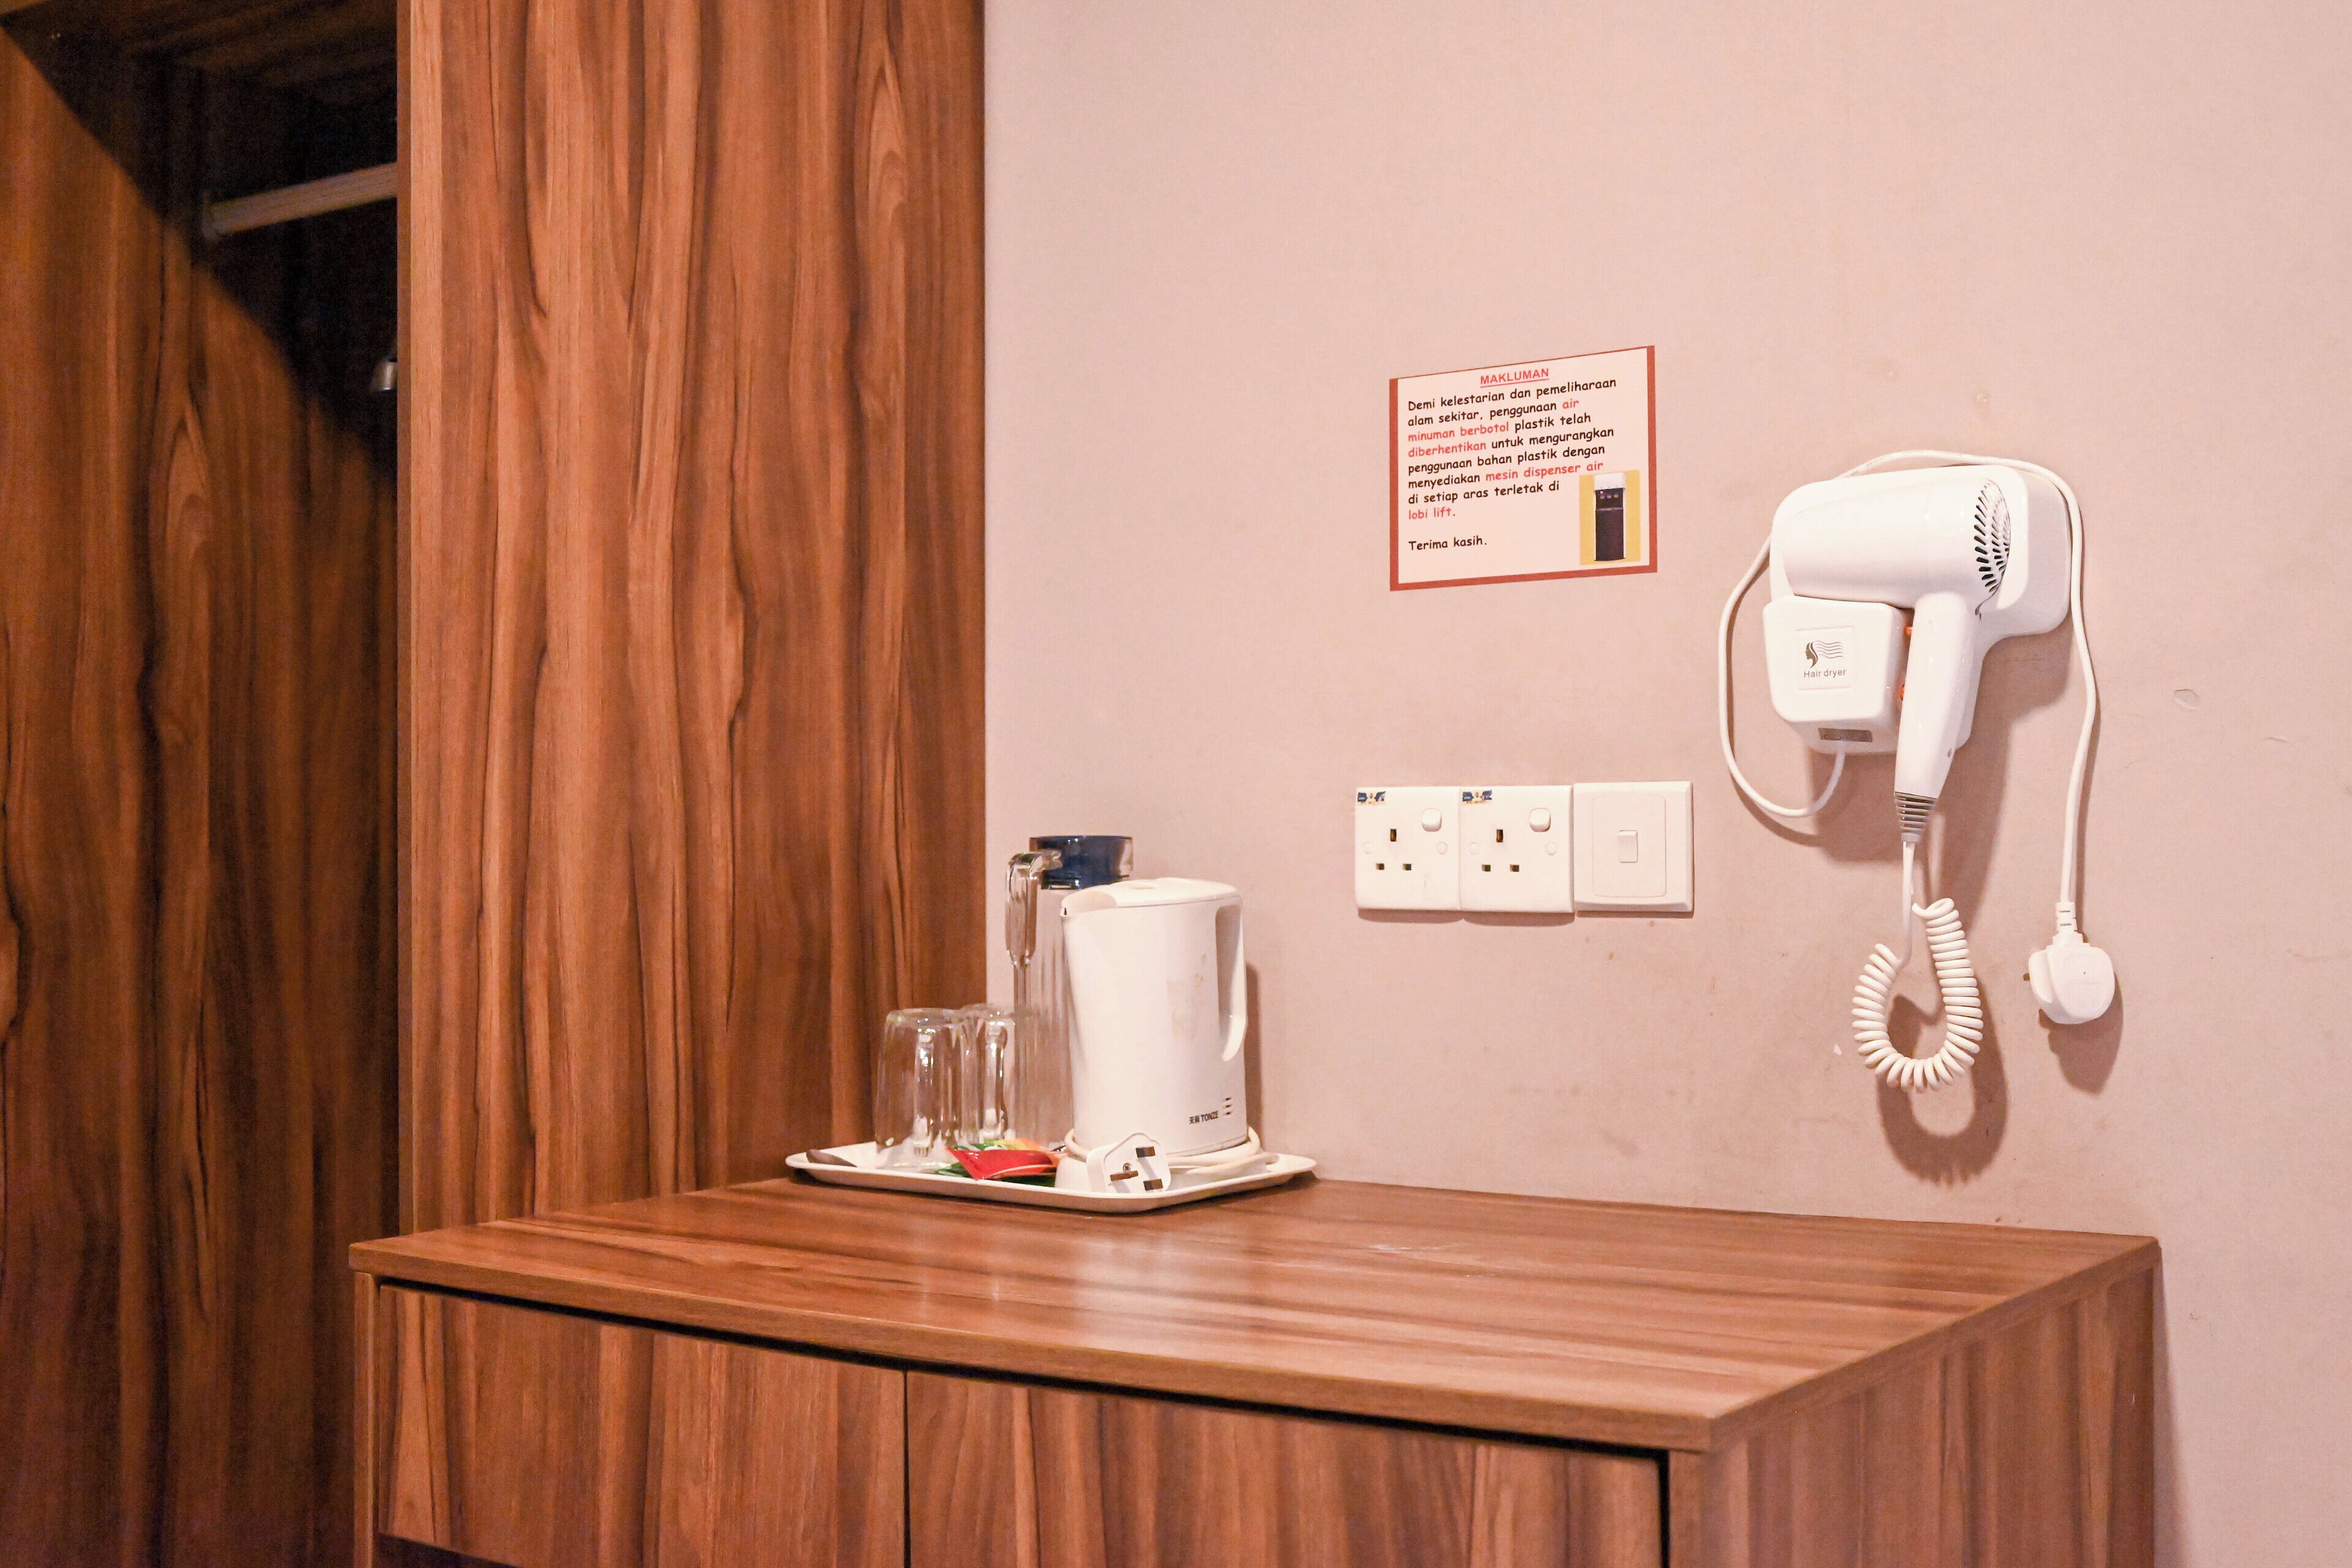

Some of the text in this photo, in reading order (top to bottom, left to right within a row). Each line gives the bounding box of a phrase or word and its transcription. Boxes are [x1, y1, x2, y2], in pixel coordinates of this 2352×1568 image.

[1480, 368, 1549, 385] MAKLUMAN
[1408, 379, 1616, 412] Demi kelestarian dan pemeliharaan
[1408, 398, 1580, 427] alam sekitar, penggunaan air
[1408, 412, 1591, 442] minuman berbotol plastik telah
[1408, 427, 1614, 458] diberhentikan untuk mengurangkan
[1408, 446, 1605, 476] penggunaan bahan plastik dengan
[1408, 461, 1604, 490] menyediakan mesin dispenser air
[1408, 480, 1559, 505] di setiap aras terletak di
[1409, 506, 1456, 520] lobi lift.
[1408, 535, 1487, 551] Terima kasih.
[1823, 669, 1846, 678] dryer
[1200, 1110, 1219, 1122] TONZE
